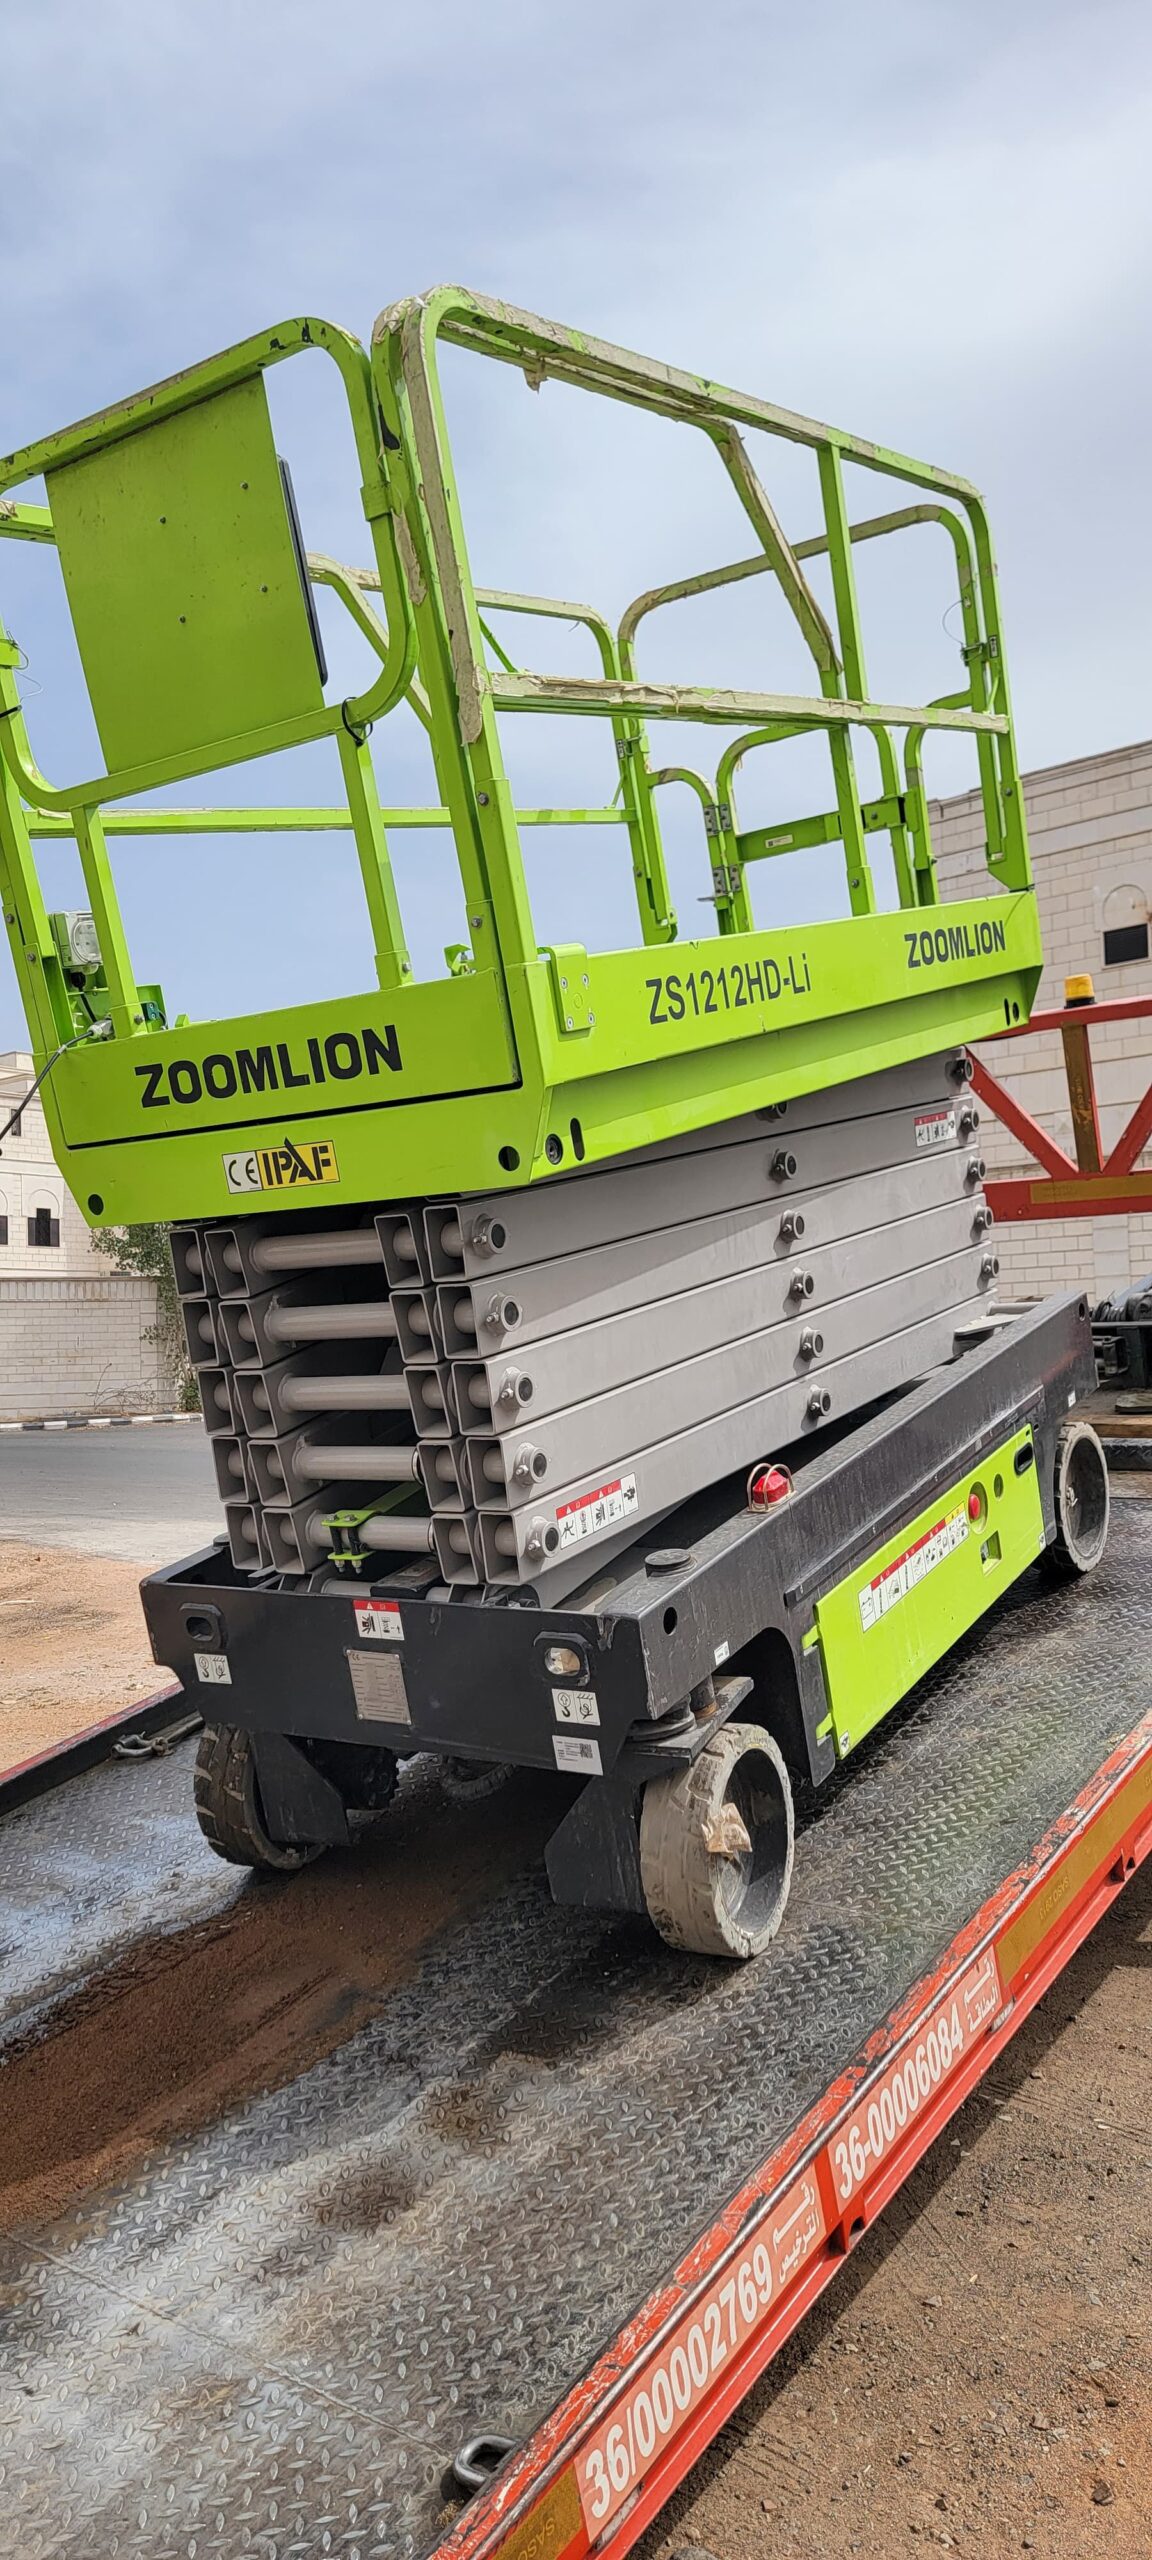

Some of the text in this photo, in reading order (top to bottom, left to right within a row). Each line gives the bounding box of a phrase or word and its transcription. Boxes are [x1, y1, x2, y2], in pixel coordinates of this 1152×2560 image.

[905, 921, 1006, 968] ZOOMLION
[646, 954, 811, 1024] ZS1212HD-Li
[135, 1025, 402, 1107] ZOOMLION
[262, 1137, 331, 1185] IPAF
[834, 2001, 964, 2199] 36-00006084
[778, 2211, 821, 2282] الترخيص
[585, 2243, 773, 2519] 36/00002769
